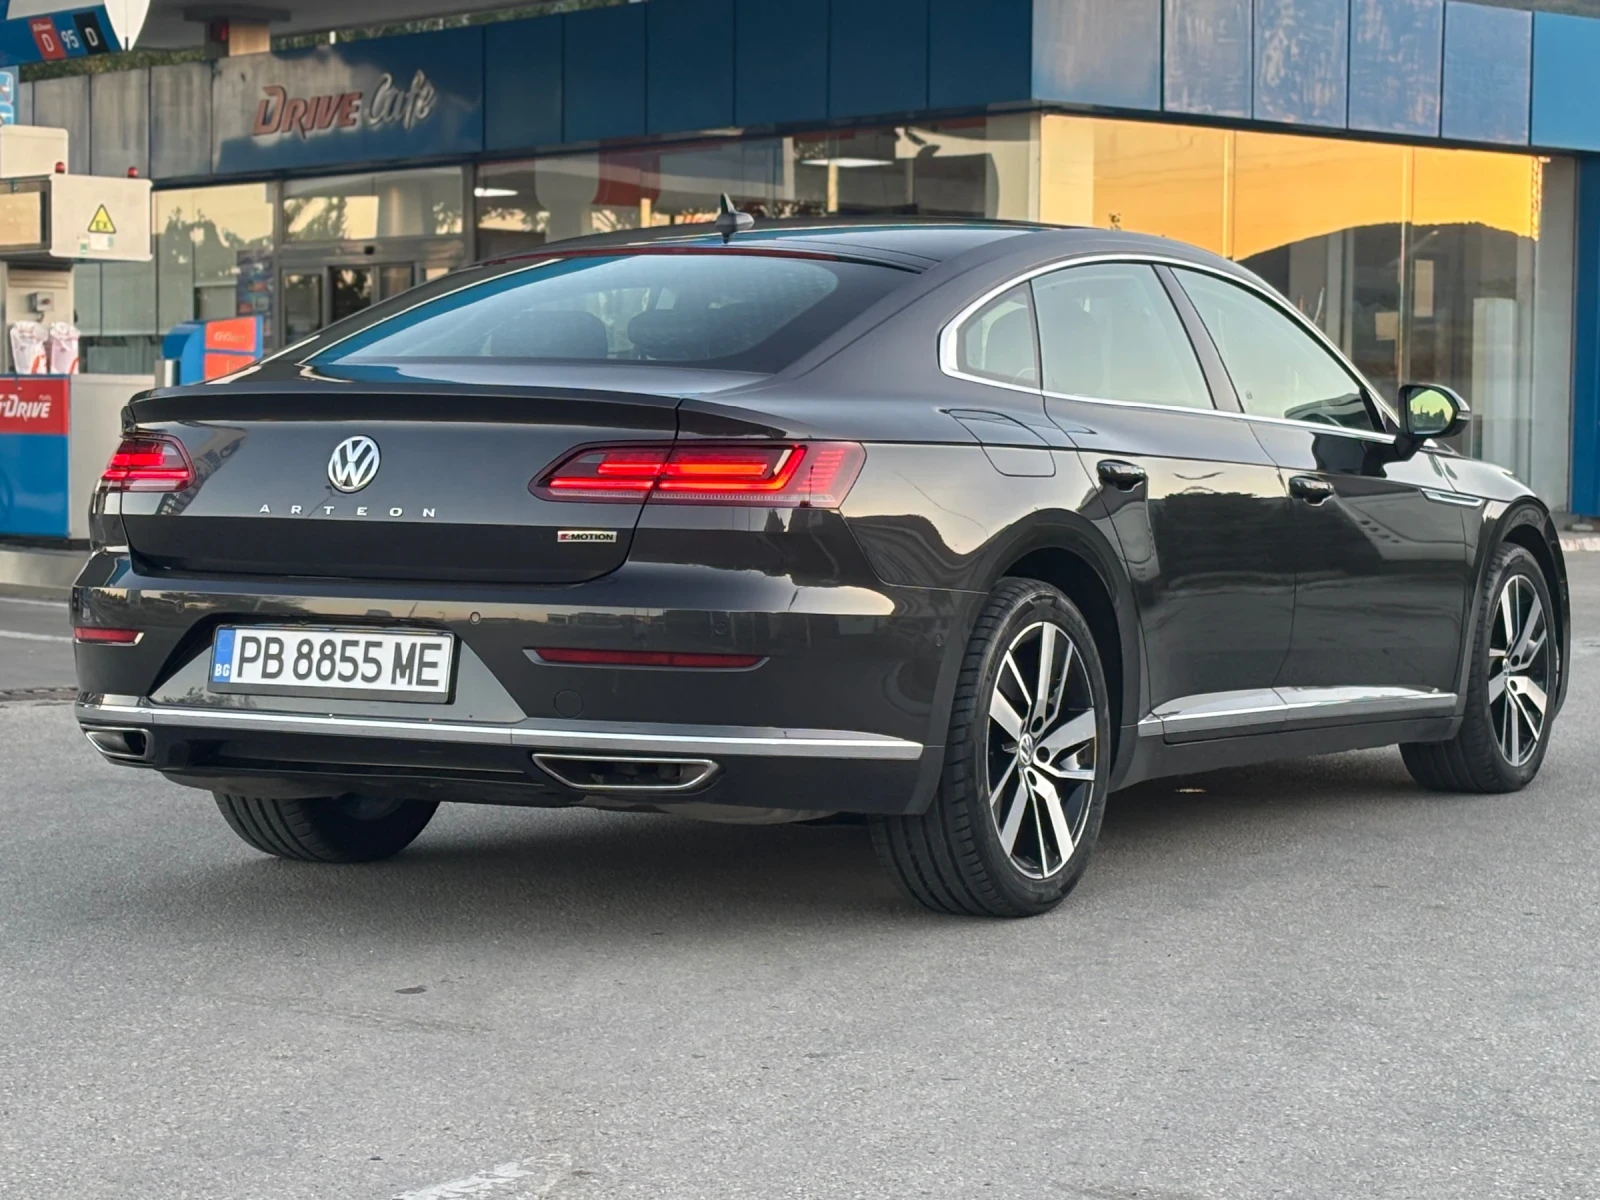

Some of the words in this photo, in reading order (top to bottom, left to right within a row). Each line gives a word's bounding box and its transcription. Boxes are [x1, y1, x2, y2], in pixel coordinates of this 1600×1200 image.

[60, 29, 80, 49] 95
[253, 85, 363, 139] DRIVE
[260, 503, 436, 518] ARTEON
[214, 663, 230, 676] BG
[237, 636, 284, 679] PB
[293, 638, 382, 682] 8855
[391, 641, 442, 686] ME
